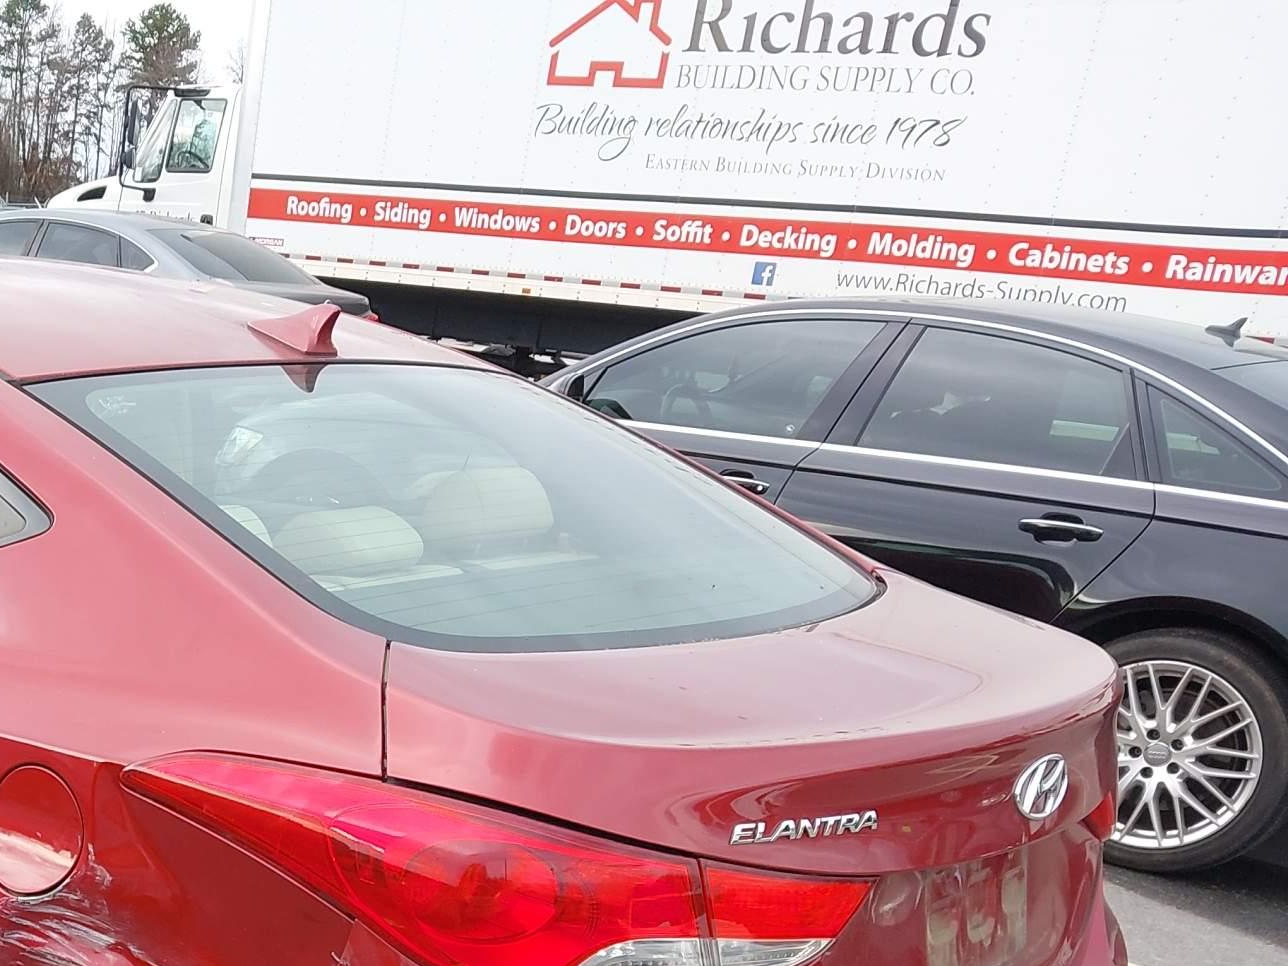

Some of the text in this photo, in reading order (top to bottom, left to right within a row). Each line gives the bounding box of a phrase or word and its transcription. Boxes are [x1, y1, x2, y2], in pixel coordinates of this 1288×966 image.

[682, 0, 992, 58] Richards
[676, 64, 975, 96] BUILDING SUPPLY CO.
[534, 101, 968, 162] Building relationships since 1978
[286, 195, 353, 224] Roofing
[373, 201, 432, 230] Siding
[454, 207, 541, 233] Windows
[564, 214, 627, 239] Doors
[652, 219, 714, 244] Soffit
[740, 224, 838, 257] Decking
[867, 231, 976, 268] Molding
[1008, 242, 1131, 275] Cabinets
[729, 810, 878, 846] ELANTRA
